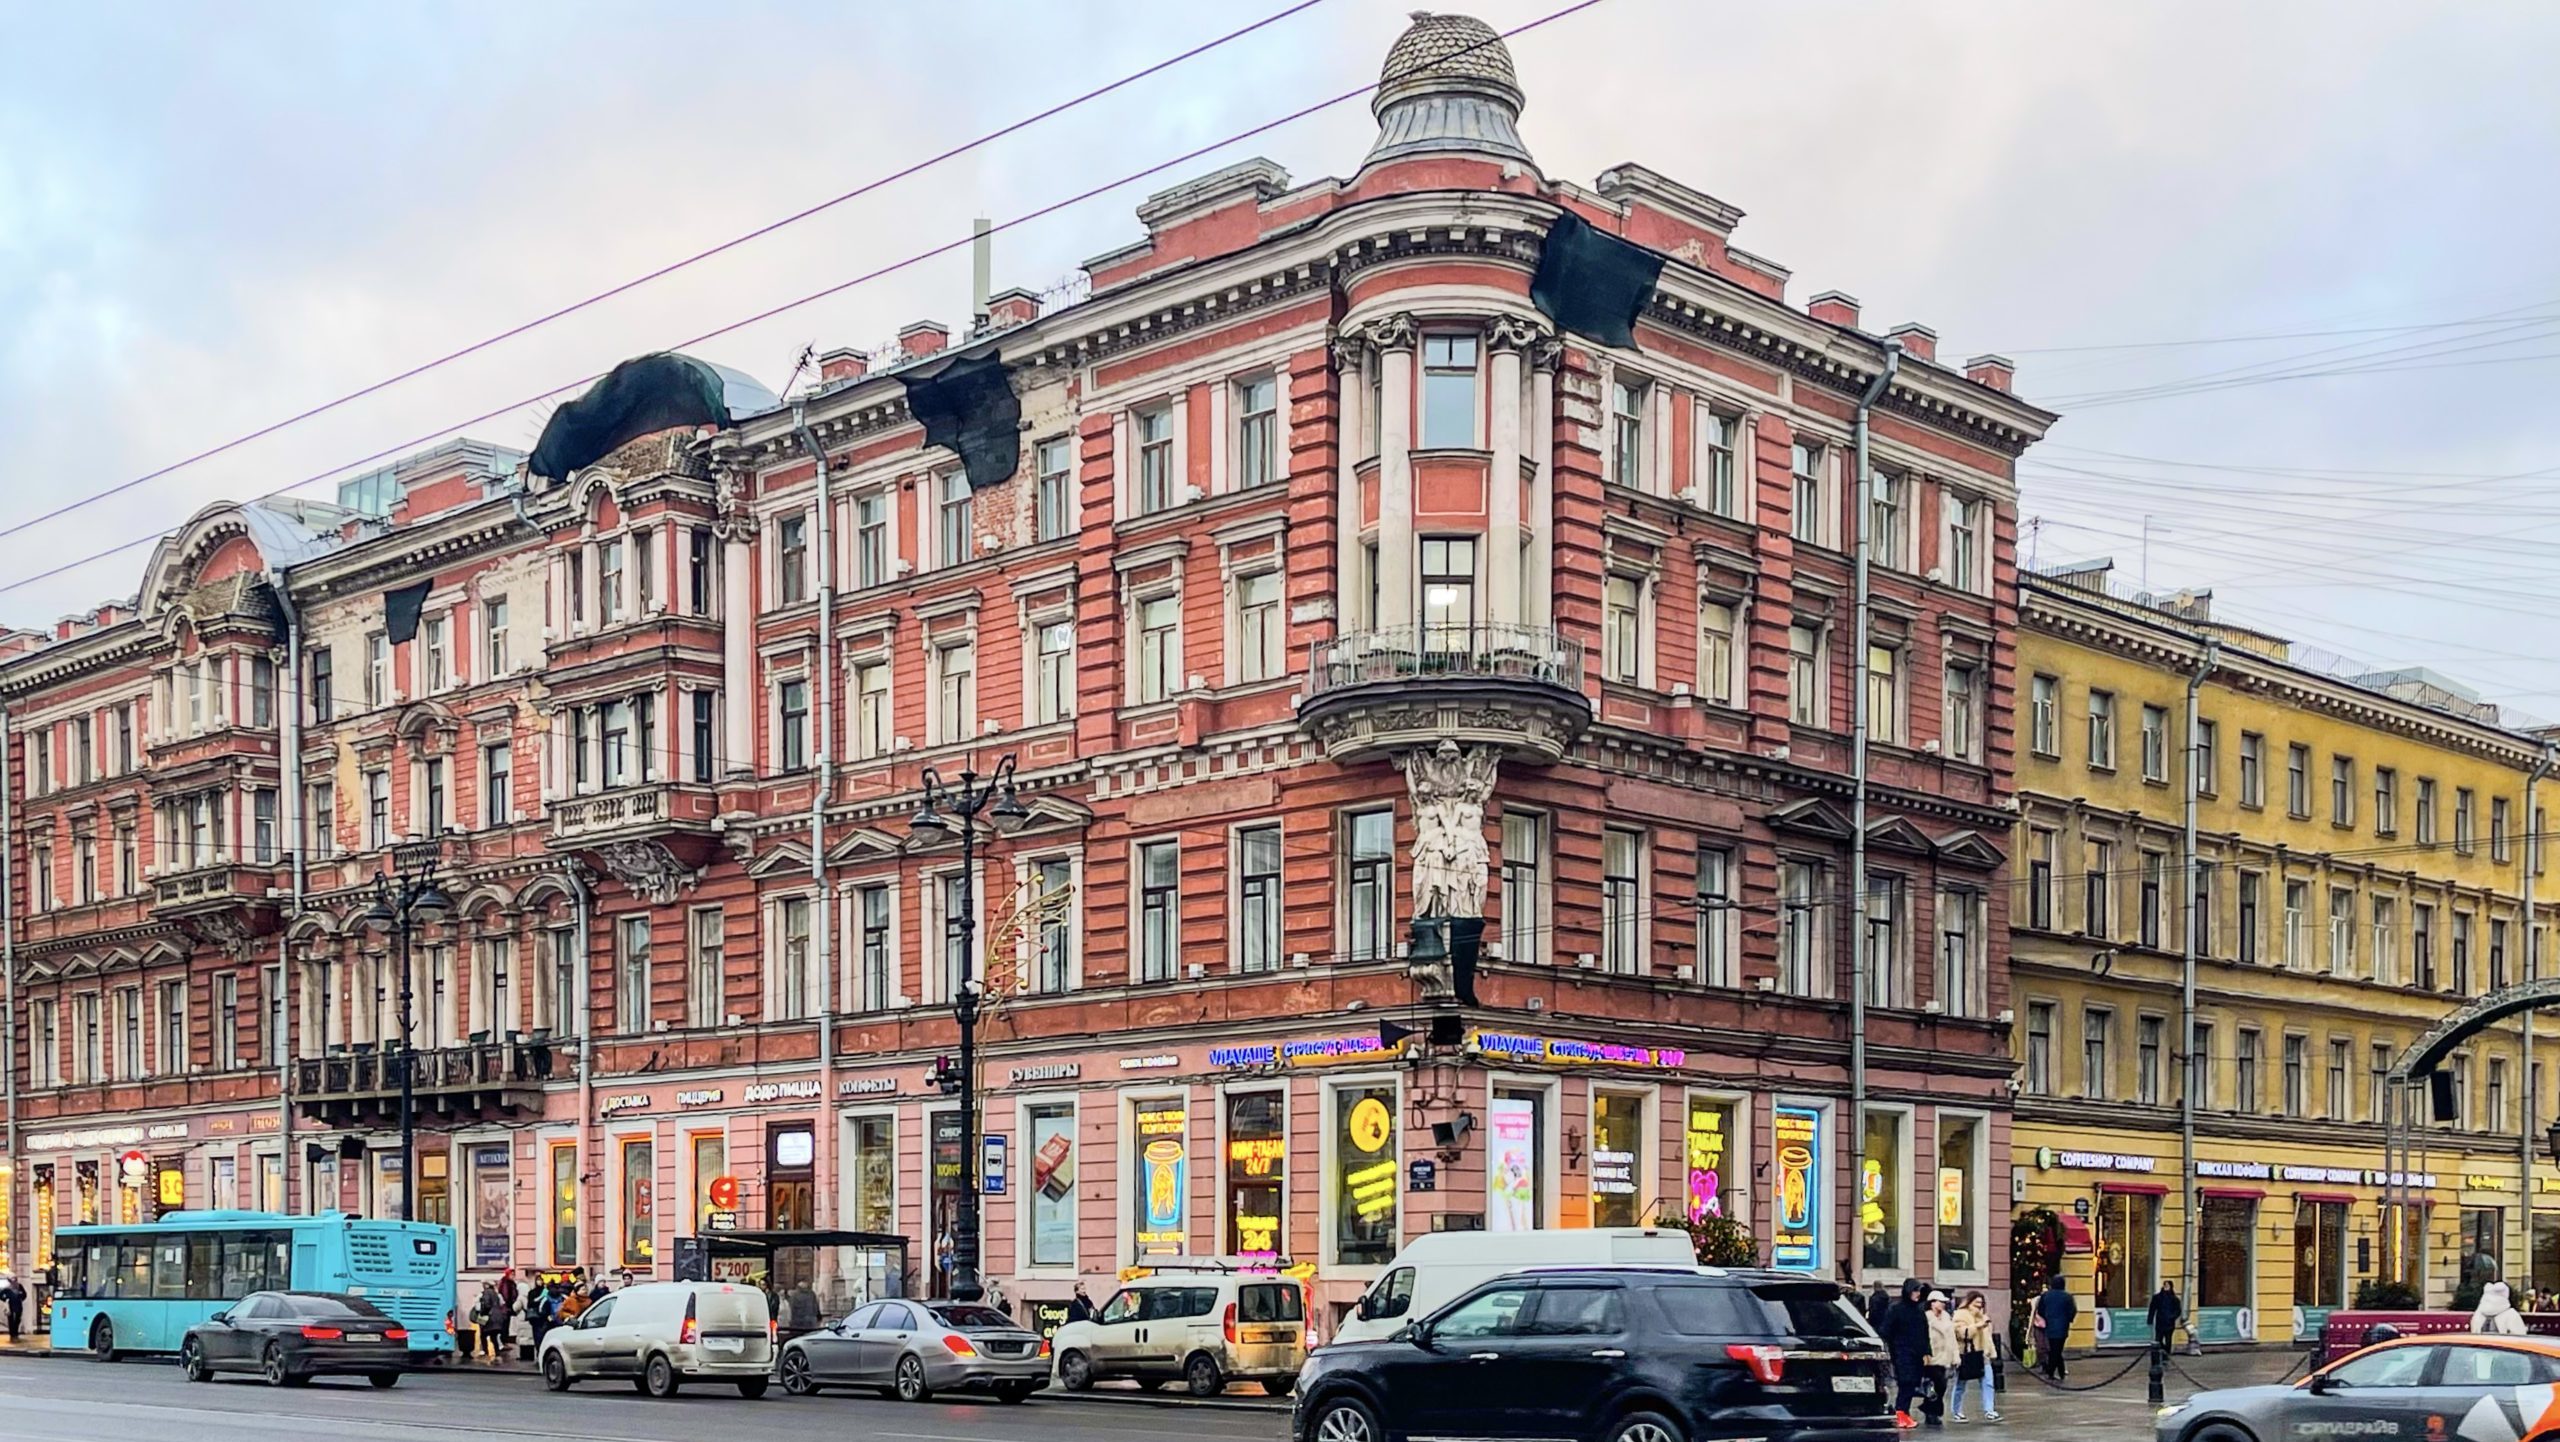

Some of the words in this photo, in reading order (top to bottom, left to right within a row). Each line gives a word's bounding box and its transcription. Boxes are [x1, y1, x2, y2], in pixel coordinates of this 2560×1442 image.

[1008, 1063, 1080, 1082] СУВЕНИРЫ
[744, 1084, 779, 1102] ДОДО
[778, 1080, 822, 1098] ПИЦЦА
[838, 1078, 896, 1095] КОНФЕТЫ
[608, 1095, 650, 1110] ДОСТАВКА
[676, 1089, 721, 1105] ПИЦЦЕРИЯ
[1245, 1157, 1272, 1175] 24/7
[2061, 1152, 2113, 1168] COFFEESHOP
[2115, 1156, 2155, 1171] COMPANY
[2284, 1166, 2326, 1181] COFFEESHOP
[2327, 1169, 2361, 1184] COMPANY
